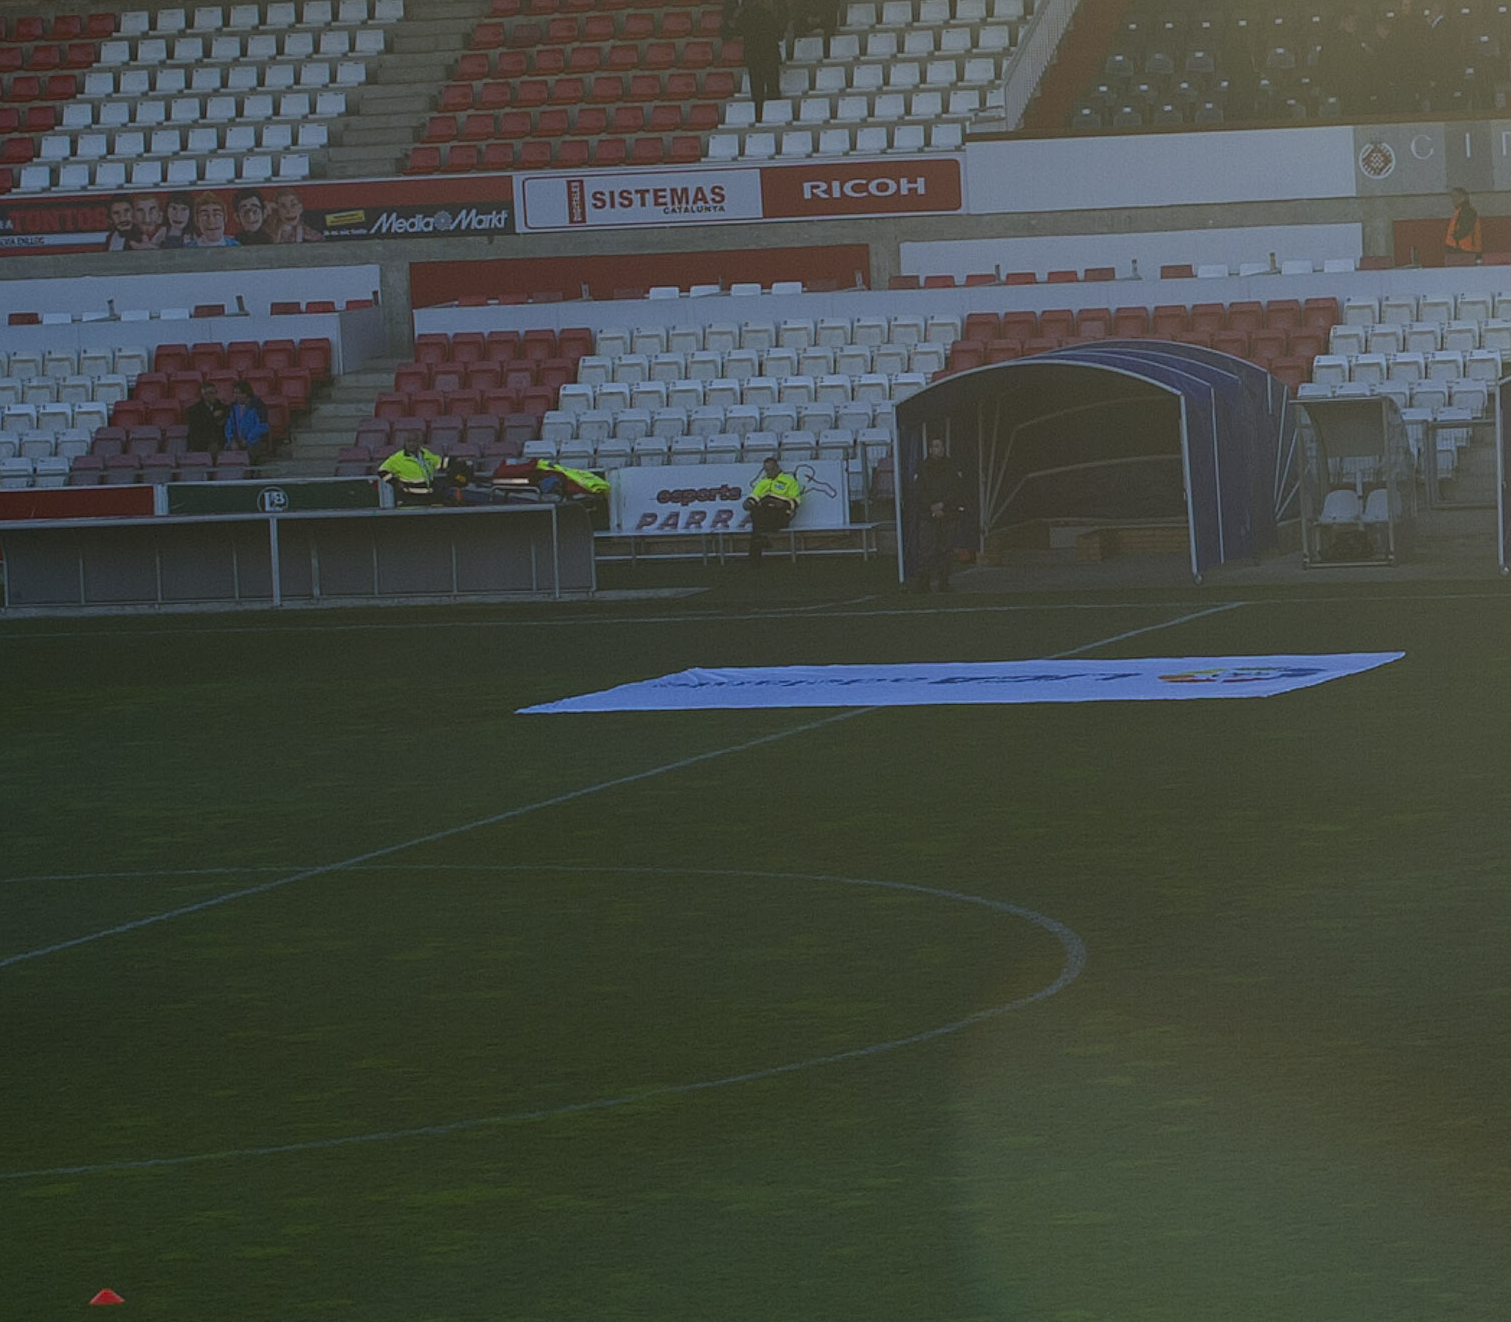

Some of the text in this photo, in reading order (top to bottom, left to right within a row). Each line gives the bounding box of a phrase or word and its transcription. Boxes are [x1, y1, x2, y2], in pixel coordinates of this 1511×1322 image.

[591, 185, 726, 210] SISTEMAS
[803, 177, 926, 200] RICOH
[369, 211, 435, 234] Media
[450, 208, 508, 231] Markt
